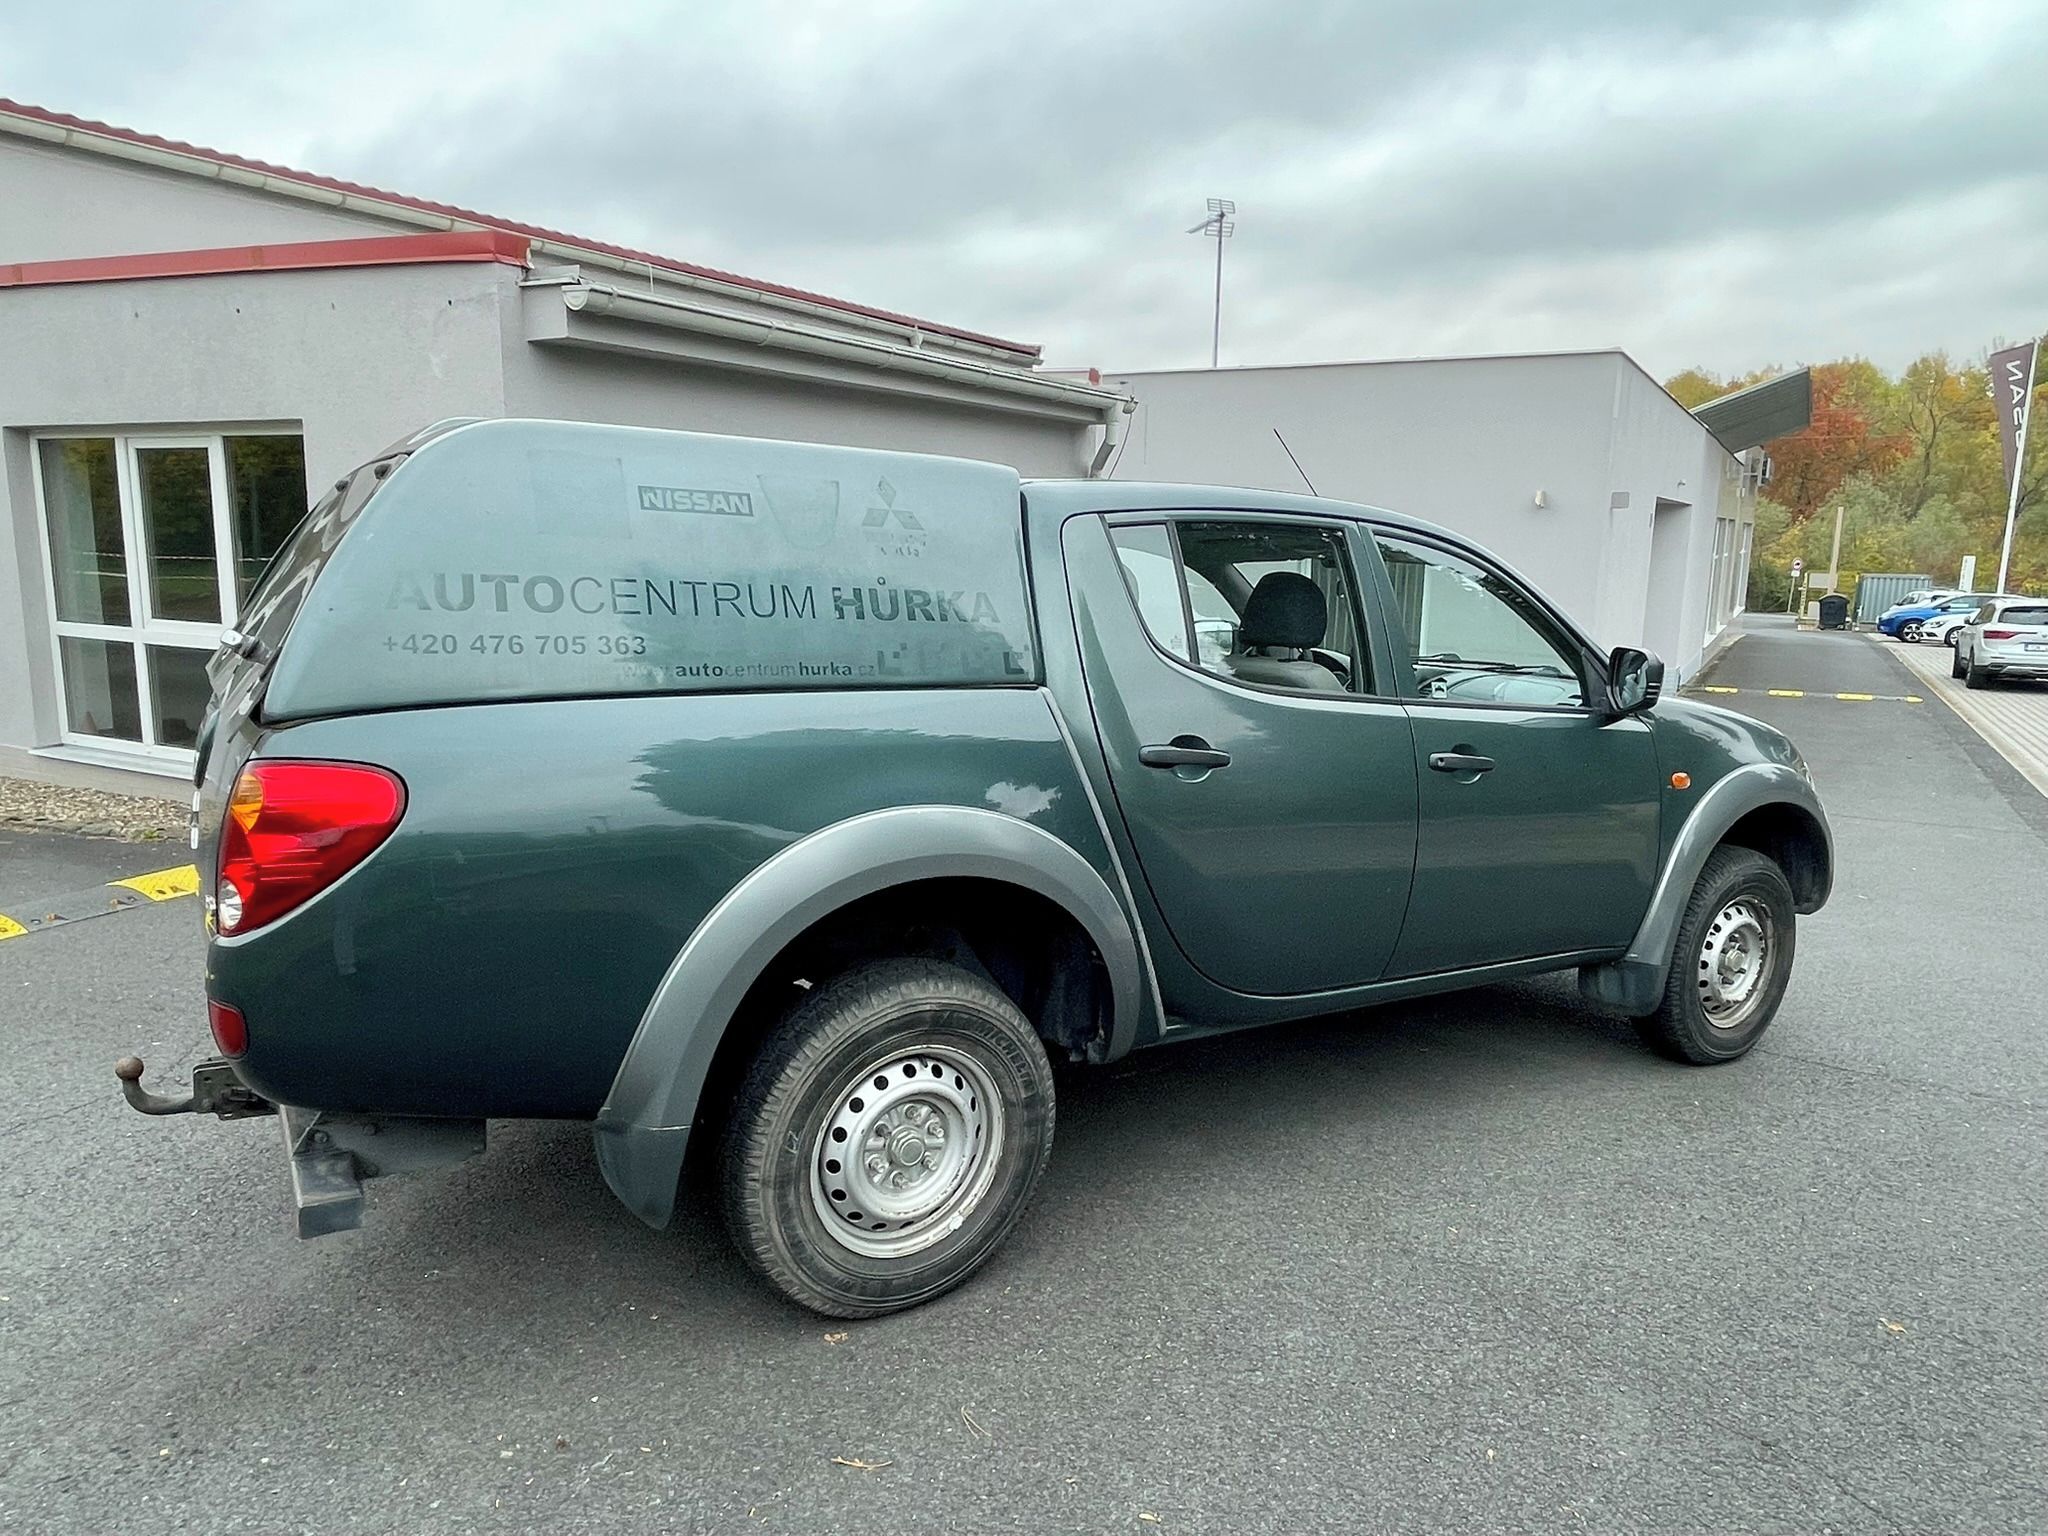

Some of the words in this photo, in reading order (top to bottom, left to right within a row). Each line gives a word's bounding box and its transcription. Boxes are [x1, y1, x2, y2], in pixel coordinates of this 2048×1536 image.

[640, 487, 750, 515] NISSAN
[385, 573, 817, 619] AUTOCENTRUM
[831, 576, 1001, 623] HŮRKA
[382, 634, 458, 655] +420
[470, 635, 524, 655] 476
[535, 635, 587, 655] 705
[598, 635, 647, 656] 363
